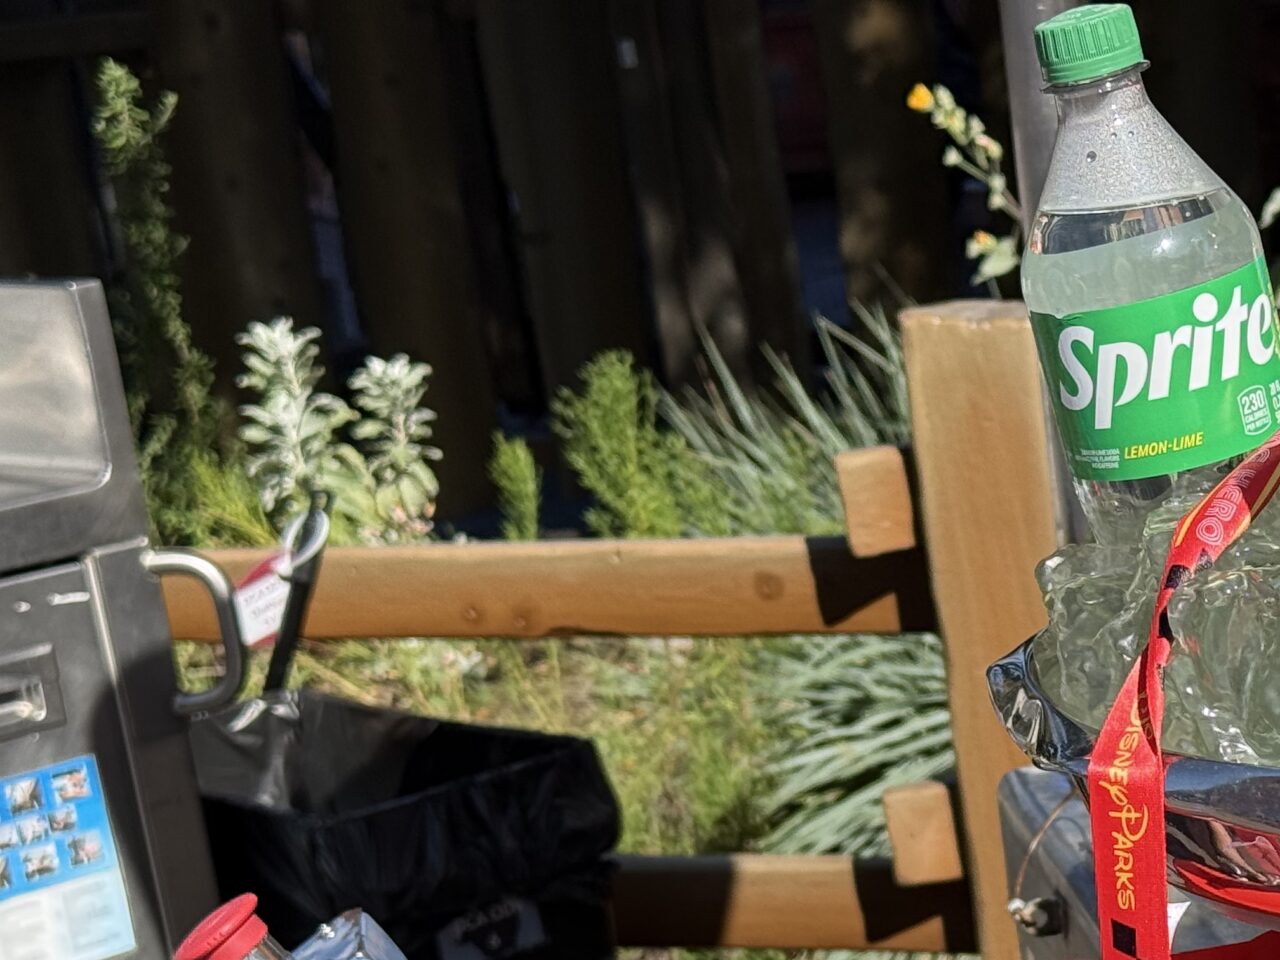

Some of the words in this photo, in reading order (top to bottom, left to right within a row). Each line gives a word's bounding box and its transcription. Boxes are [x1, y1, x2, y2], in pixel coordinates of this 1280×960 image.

[1058, 285, 1277, 430] Sprite
[1242, 390, 1265, 415] 230
[1124, 432, 1204, 460] LEMON-LIME
[1108, 802, 1149, 912] PARKS
